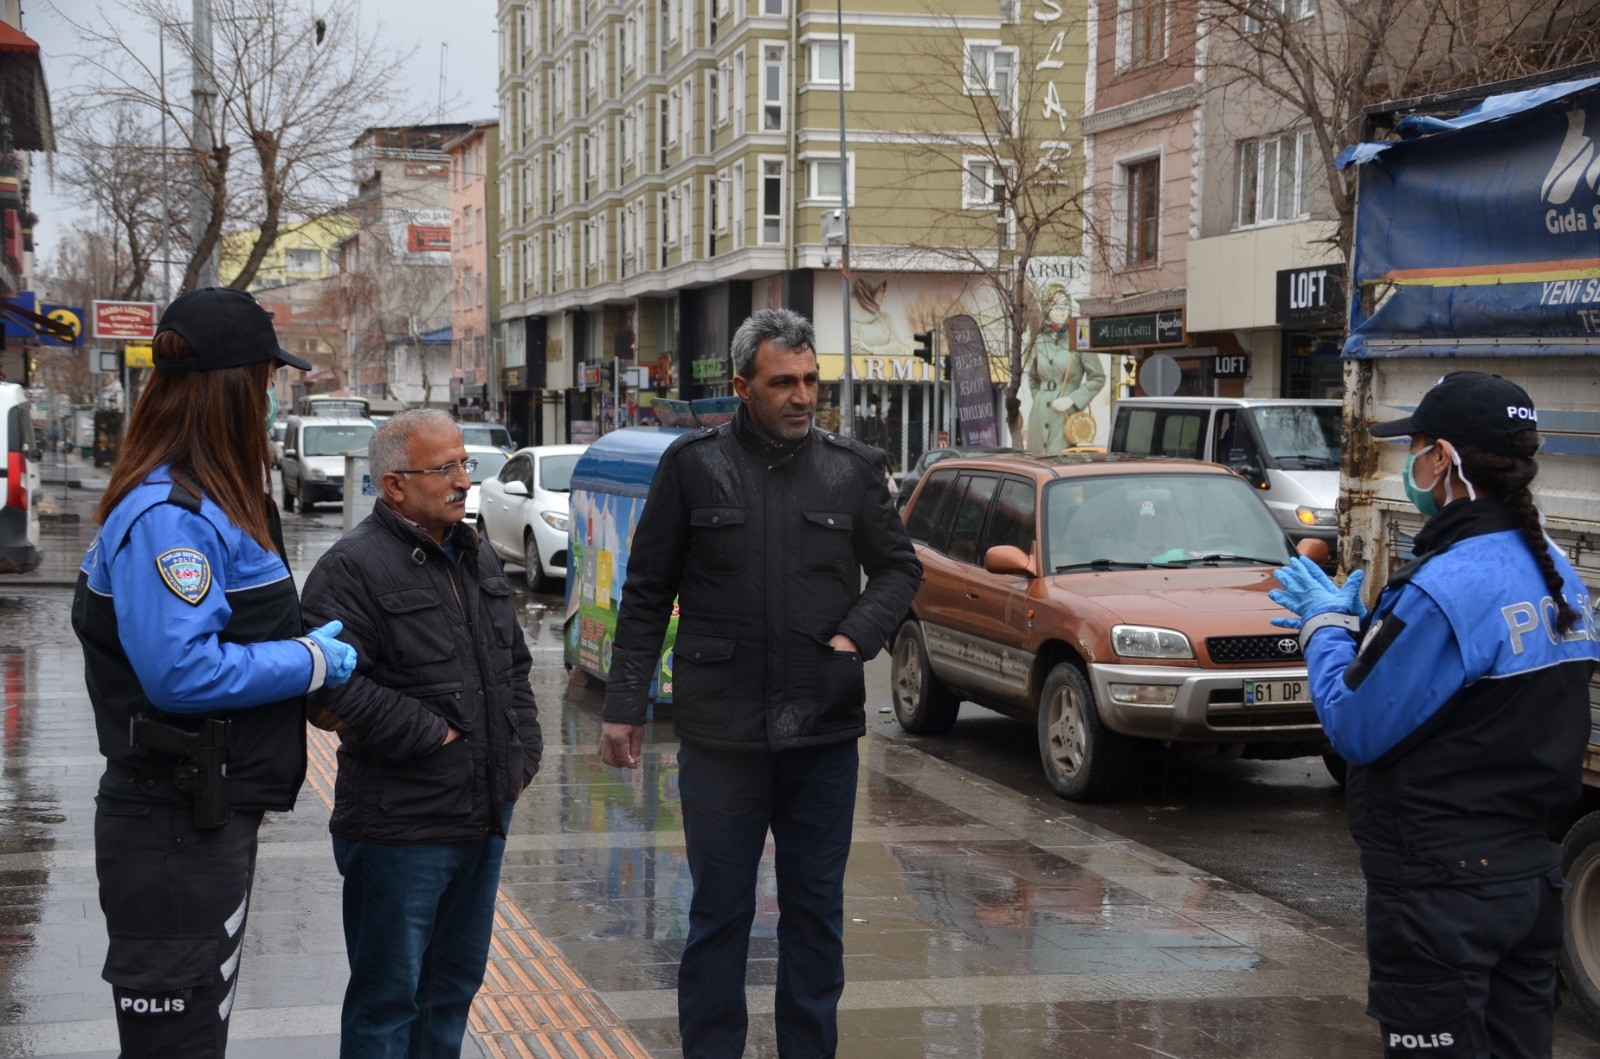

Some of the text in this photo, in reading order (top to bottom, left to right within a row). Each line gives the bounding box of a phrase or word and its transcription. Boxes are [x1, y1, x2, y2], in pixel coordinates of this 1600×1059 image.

[1545, 207, 1588, 235] Gıda
[1290, 269, 1327, 309] LOFT
[1540, 279, 1583, 306] YENİ
[1215, 356, 1246, 374] LOFT
[1255, 682, 1302, 701] 61 DP
[120, 997, 185, 1013] POLİS
[1389, 1032, 1455, 1049] POLİS
